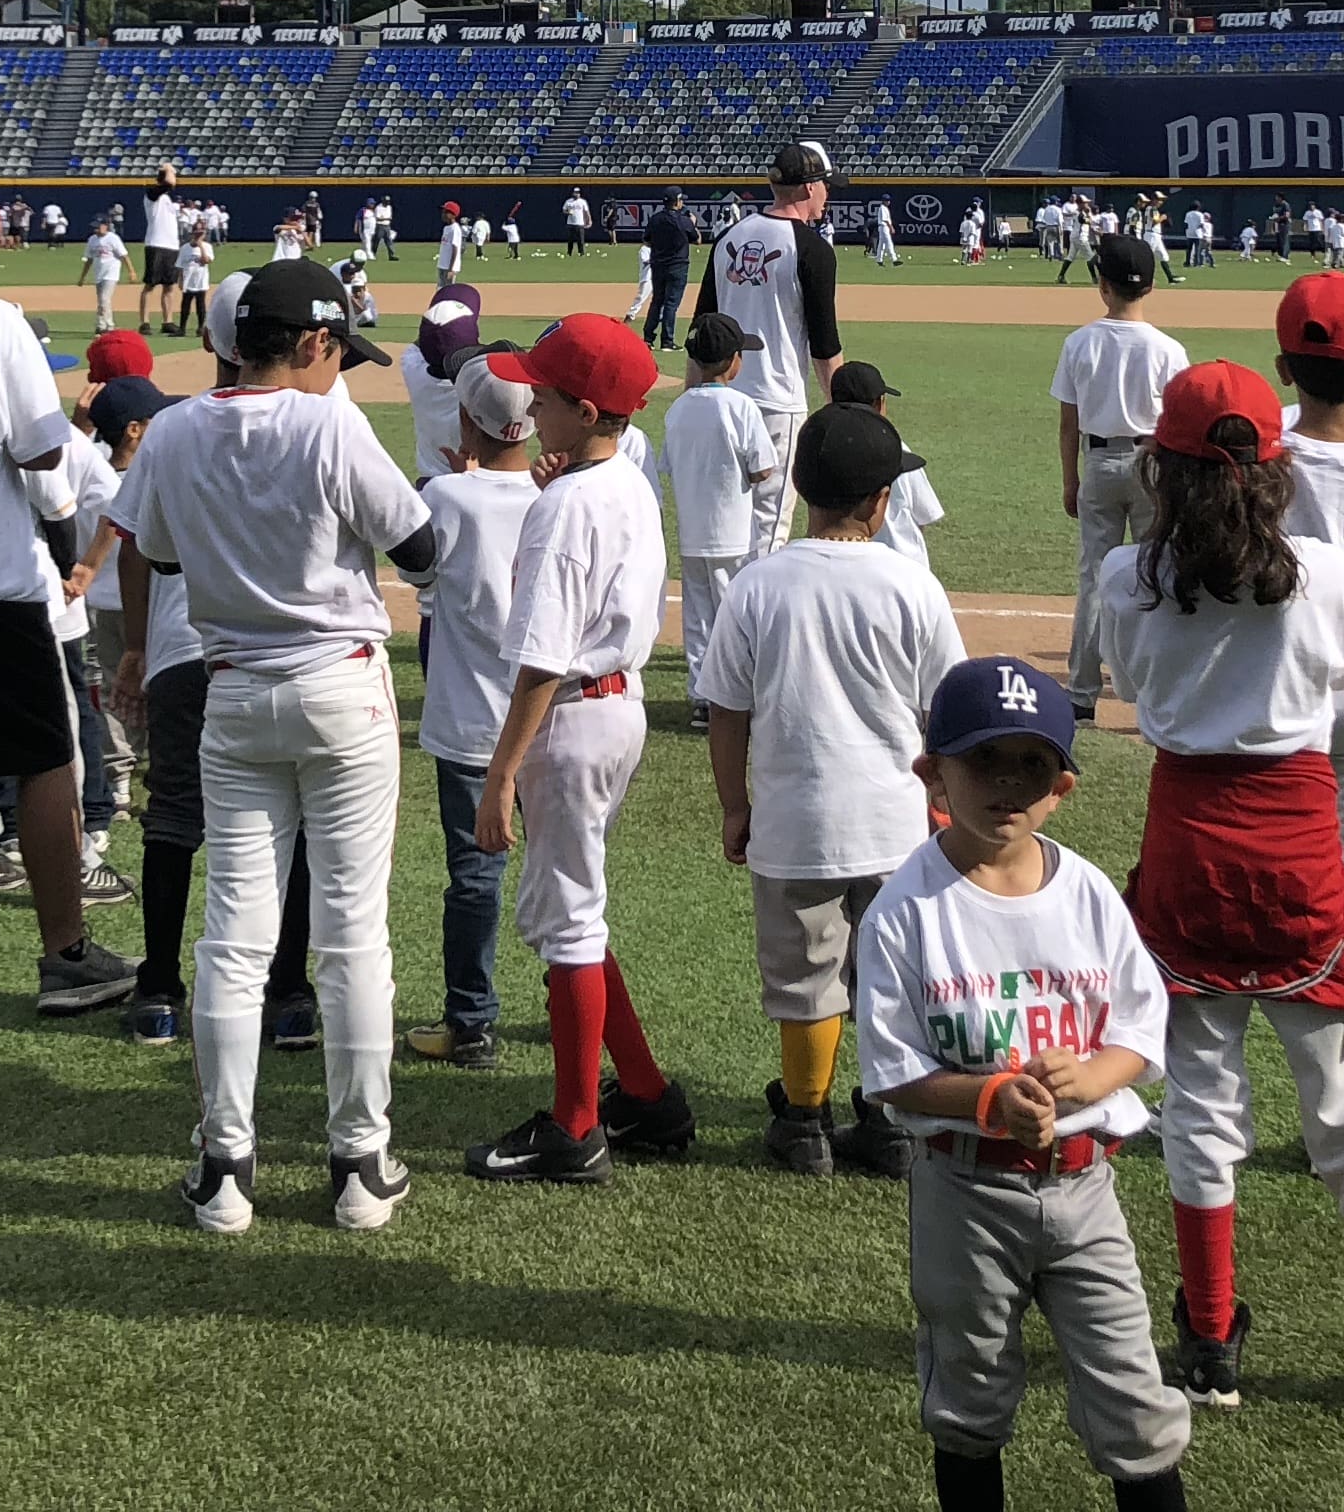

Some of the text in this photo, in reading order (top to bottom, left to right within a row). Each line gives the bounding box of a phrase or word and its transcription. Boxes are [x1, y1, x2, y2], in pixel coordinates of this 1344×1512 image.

[898, 223, 949, 235] TOYOTA
[499, 421, 523, 440] 40
[996, 665, 1039, 714] LA
[927, 1007, 1017, 1065] PLAY
